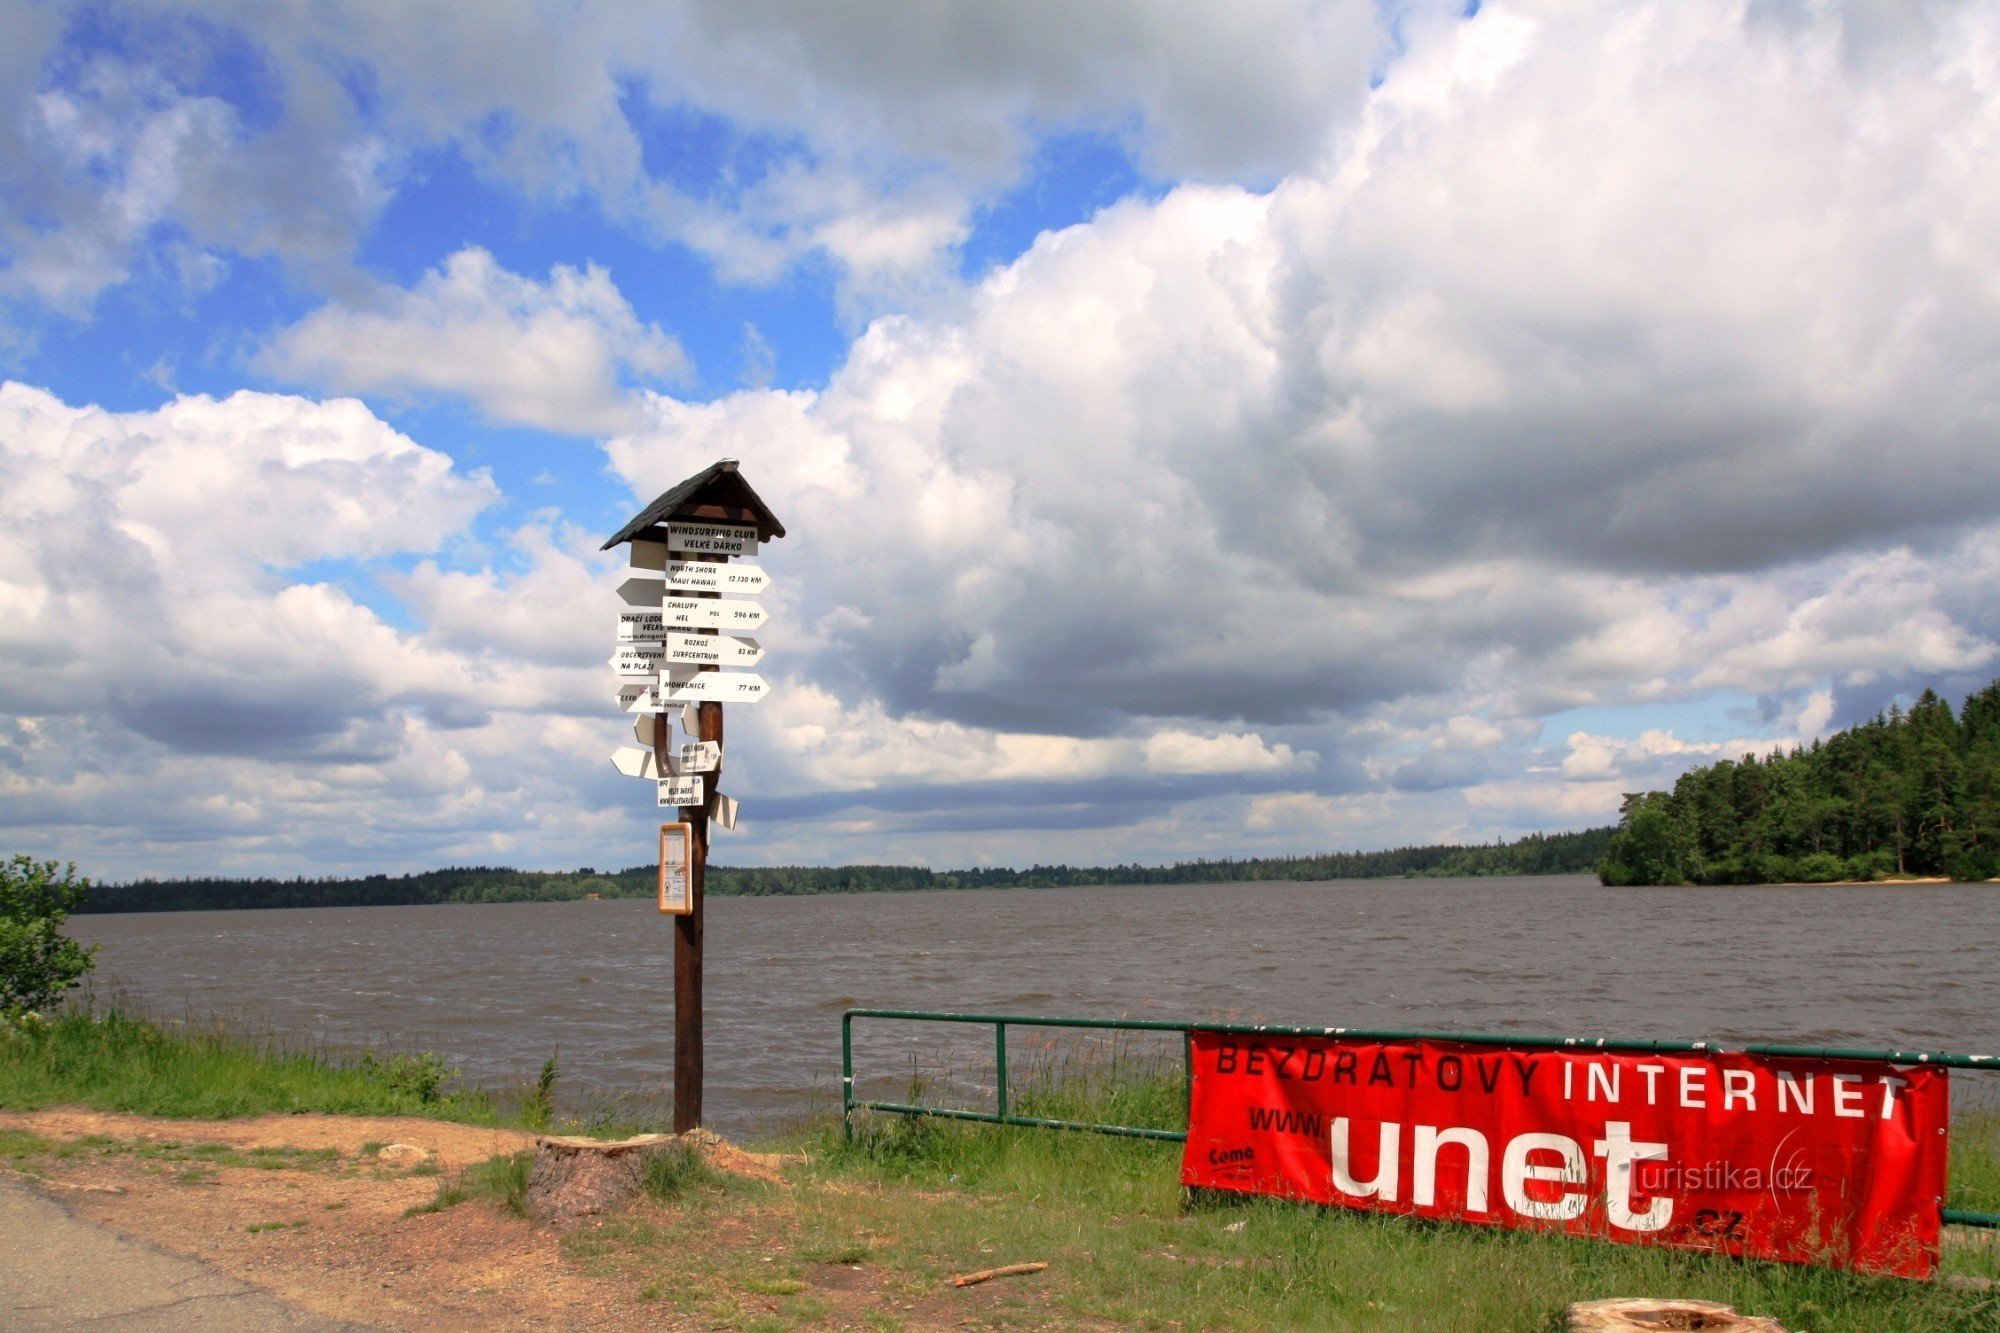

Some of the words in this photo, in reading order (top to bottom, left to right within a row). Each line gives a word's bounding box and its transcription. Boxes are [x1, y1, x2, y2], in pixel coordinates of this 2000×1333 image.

[670, 525, 731, 538] WINDSURFING
[734, 530, 755, 539] CLUB
[670, 565, 694, 573] NORTH
[670, 577, 690, 585] MAUI
[690, 578, 717, 587] HAWAII
[667, 601, 698, 610] CHALUPY
[675, 614, 689, 622] HEL
[734, 611, 747, 619] 596
[748, 612, 760, 620] KM
[672, 650, 719, 660] SURFCENTRUM
[664, 682, 706, 690] MOHELNICE
[748, 684, 761, 692] KM
[1564, 1061, 1907, 1120] INTERNET
[1331, 1117, 1673, 1232] unet
